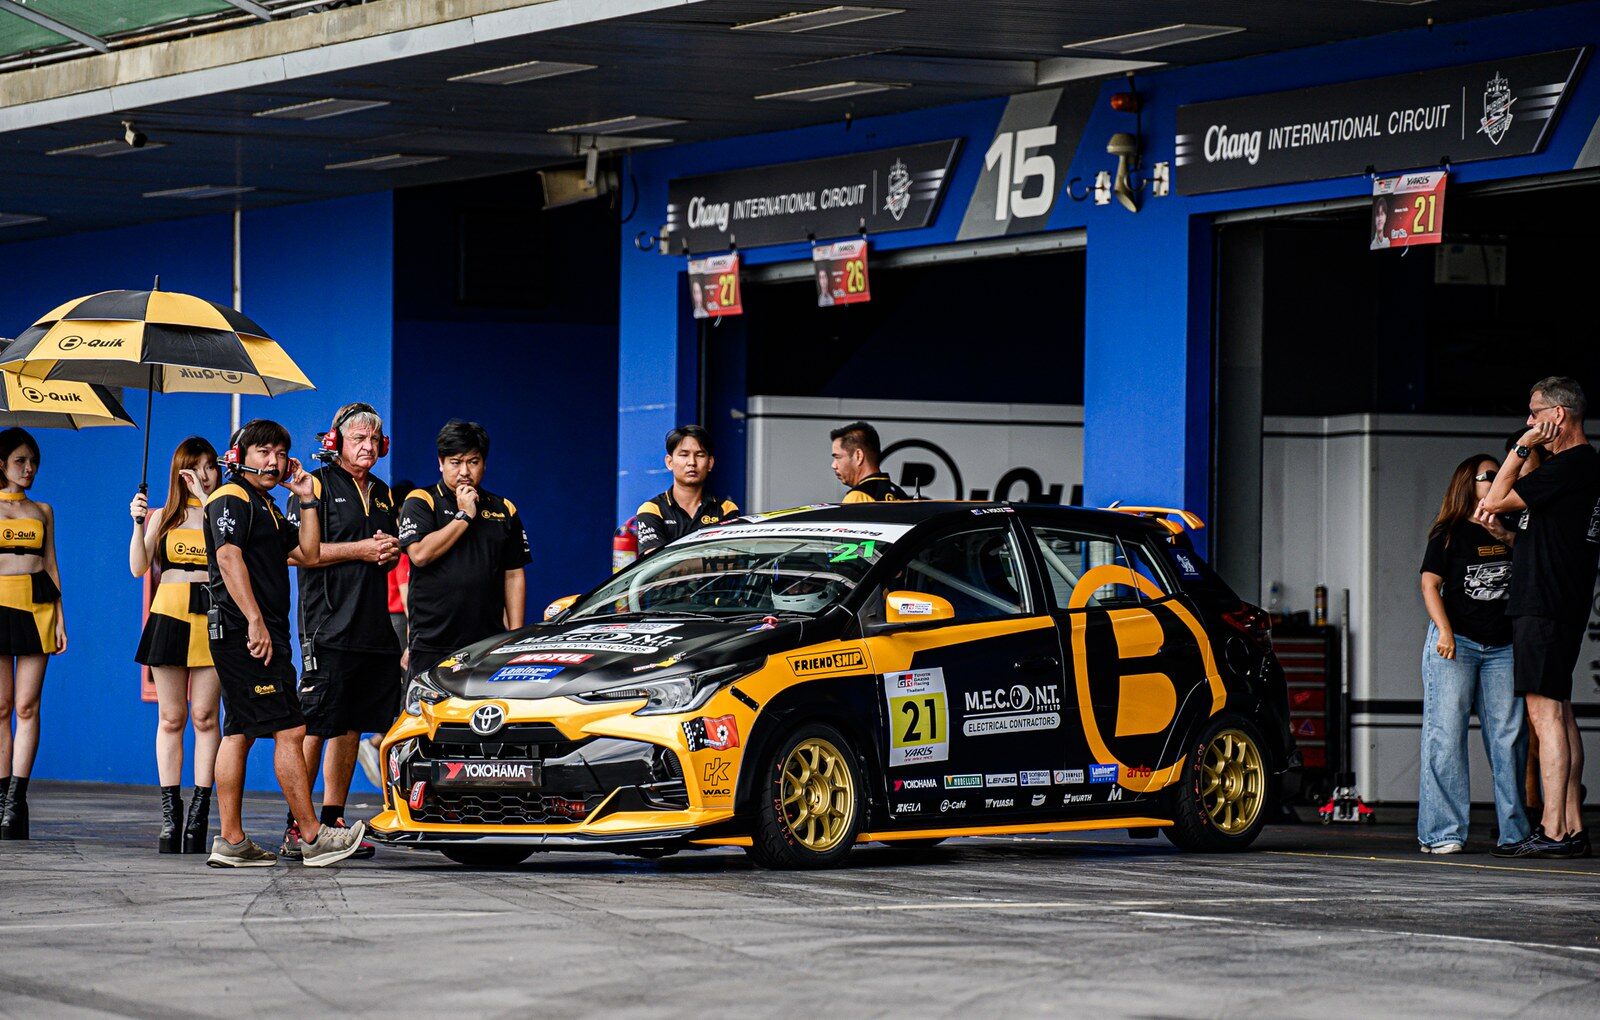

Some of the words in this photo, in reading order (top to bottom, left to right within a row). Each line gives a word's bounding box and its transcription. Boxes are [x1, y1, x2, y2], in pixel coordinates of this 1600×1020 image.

[1204, 125, 1262, 164] Chang
[1268, 113, 1381, 151] INTERNATIONAL
[1388, 103, 1451, 136] CIRCUIT
[985, 125, 1058, 221] 15
[687, 196, 730, 231] Chang
[733, 190, 817, 220] INTERNATIONAL
[820, 184, 867, 210] CIRCUIT
[1413, 194, 1436, 234] 21
[846, 260, 865, 293] 26
[719, 273, 736, 306] 27
[58, 335, 125, 351] B-Quik
[22, 386, 83, 403] B-Quik
[721, 527, 775, 535] TOYOTA
[833, 527, 883, 537] Racing
[829, 540, 875, 563] 21
[519, 653, 583, 662] MOTUL
[794, 651, 862, 671] FRIENDSHIP
[901, 698, 937, 743] 21
[968, 720, 1008, 733] ELECTRICAL
[1009, 716, 1056, 729] CONTRACTORS
[904, 746, 934, 758] YARIS
[464, 764, 527, 778] YOKOHAMA
[987, 775, 1016, 784] LENSO
[903, 778, 938, 790] YOKOHAMA
[992, 798, 1014, 808] YUASA
